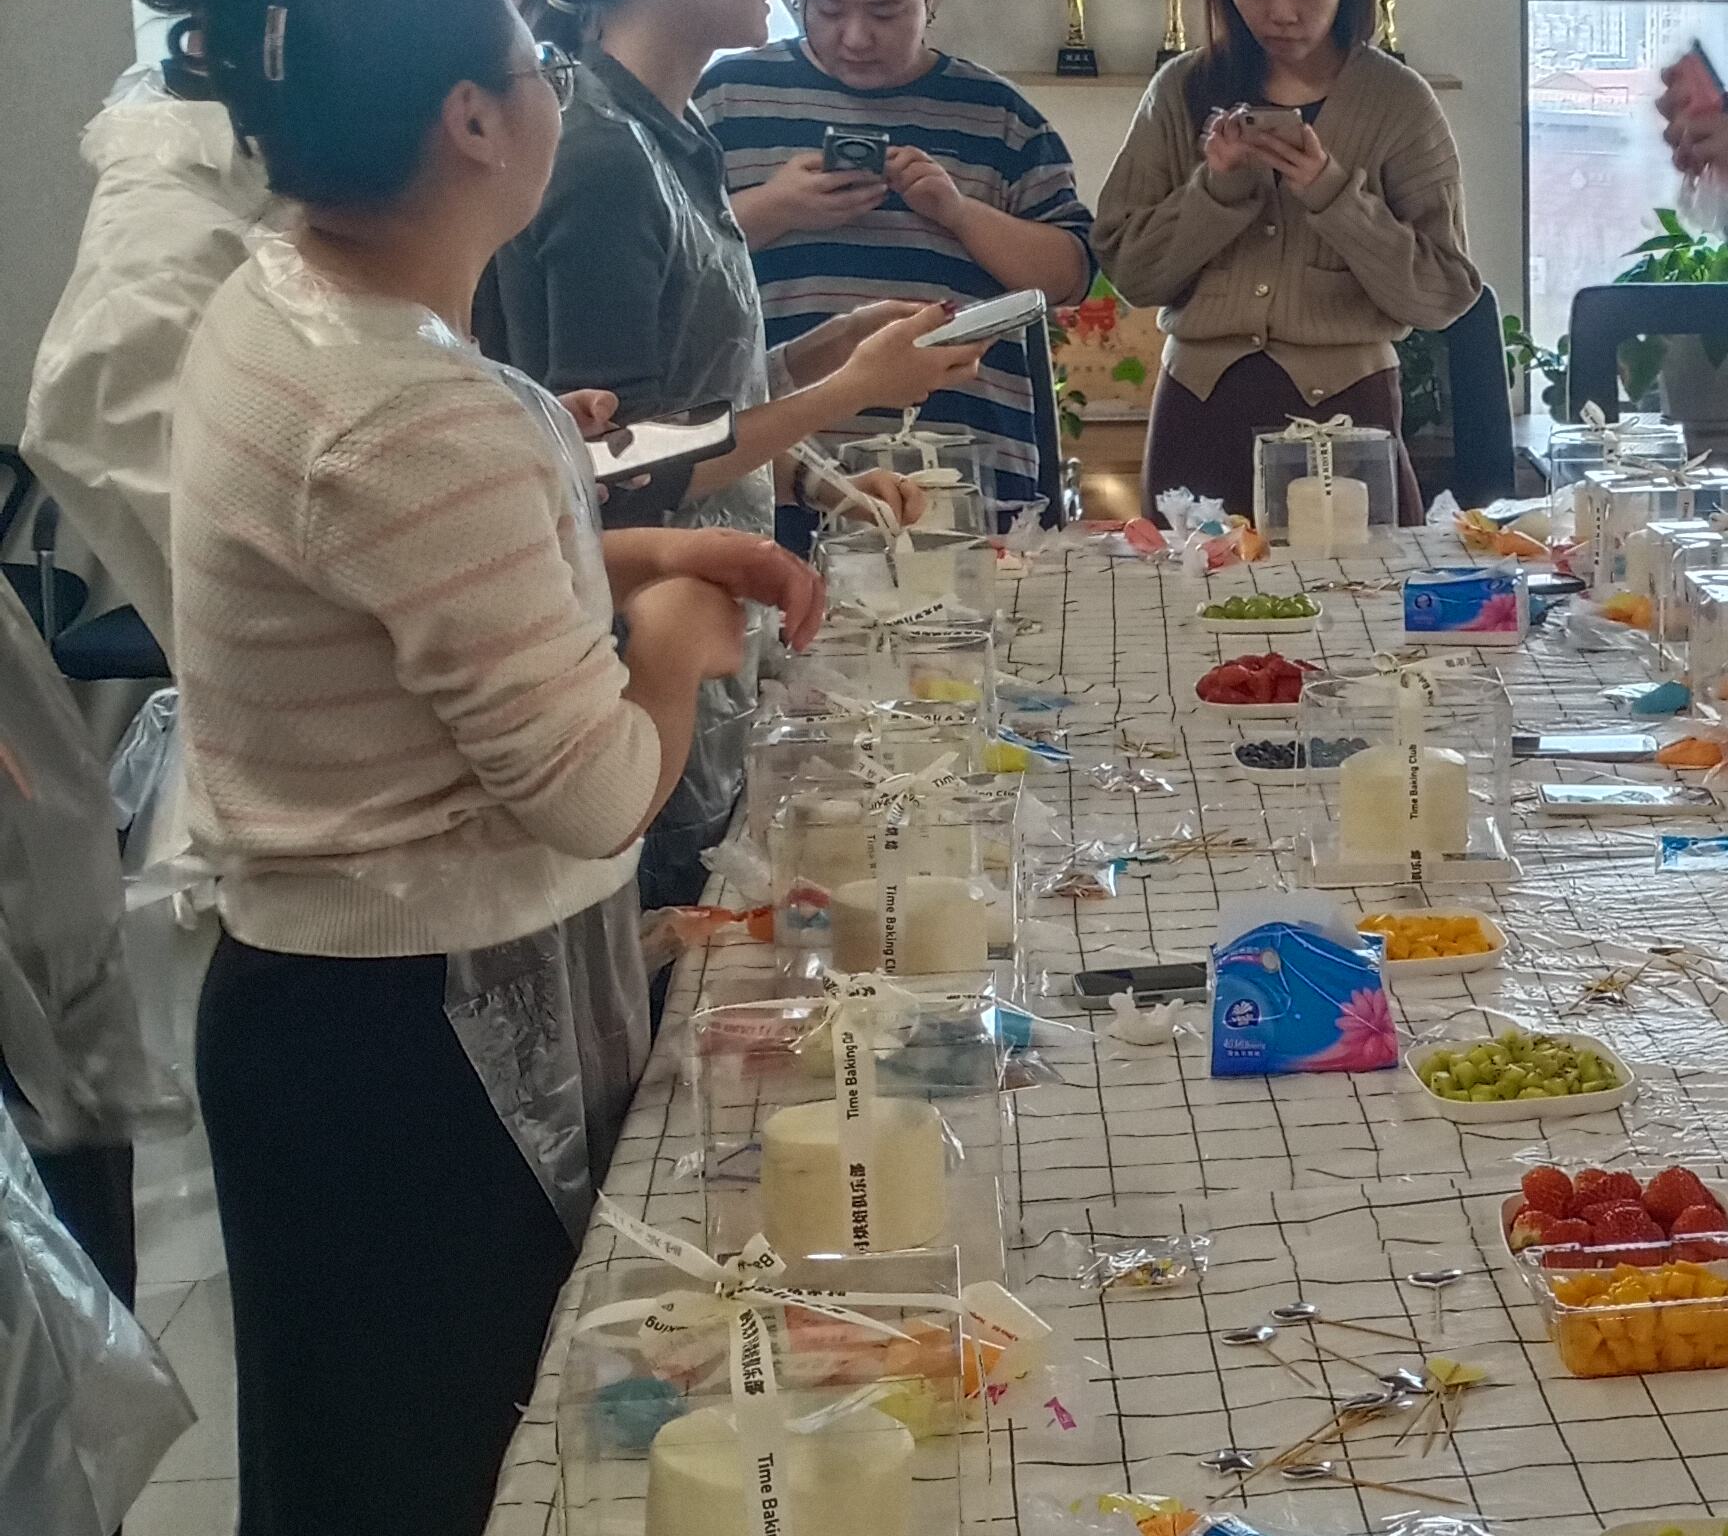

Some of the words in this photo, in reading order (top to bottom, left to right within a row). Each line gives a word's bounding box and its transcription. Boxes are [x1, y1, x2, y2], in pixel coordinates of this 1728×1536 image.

[1408, 743, 1418, 764] Club
[931, 774, 956, 789] Tim
[1408, 766, 1418, 793] Baking
[1409, 794, 1419, 820] Time
[886, 884, 897, 913] Time
[883, 916, 897, 956] Baking
[844, 1041, 858, 1090] Baking
[846, 1092, 859, 1120] Time
[758, 1452, 773, 1495] Time
